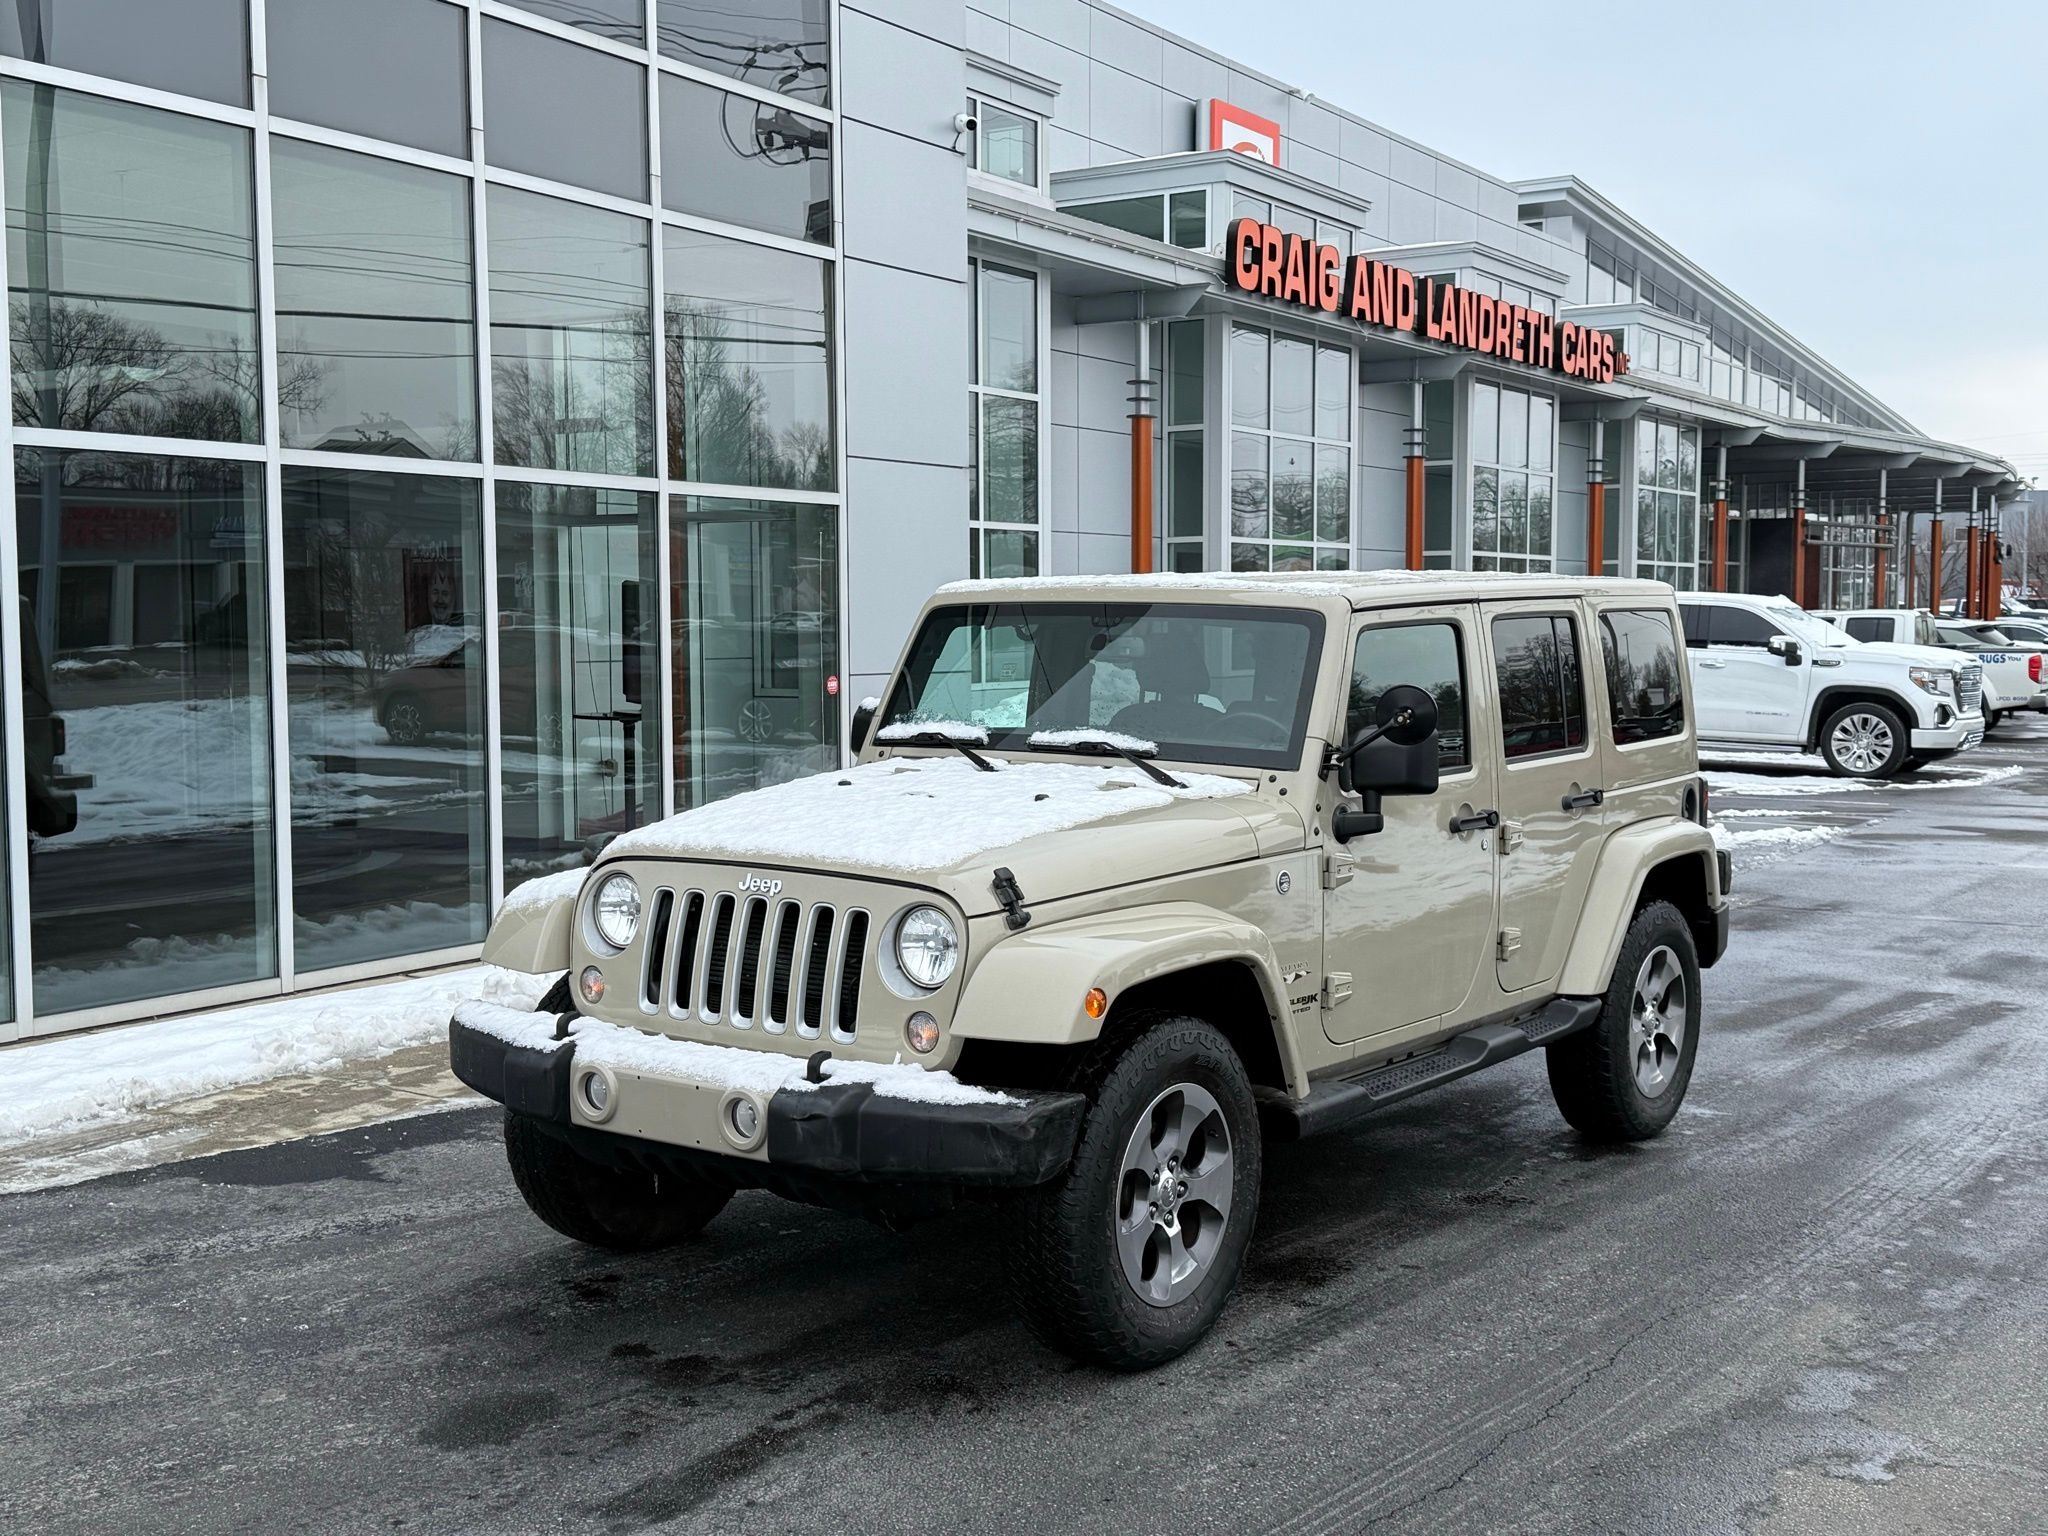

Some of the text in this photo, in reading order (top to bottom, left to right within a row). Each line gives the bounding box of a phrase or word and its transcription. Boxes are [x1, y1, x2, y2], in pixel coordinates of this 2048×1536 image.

[1230, 217, 1340, 312] CRAIG
[1350, 255, 1415, 332] AND
[1424, 278, 1555, 369] LANDRETH
[1559, 320, 1615, 384] CARS
[1978, 654, 2006, 664] BUGS
[738, 872, 782, 897] Jeep
